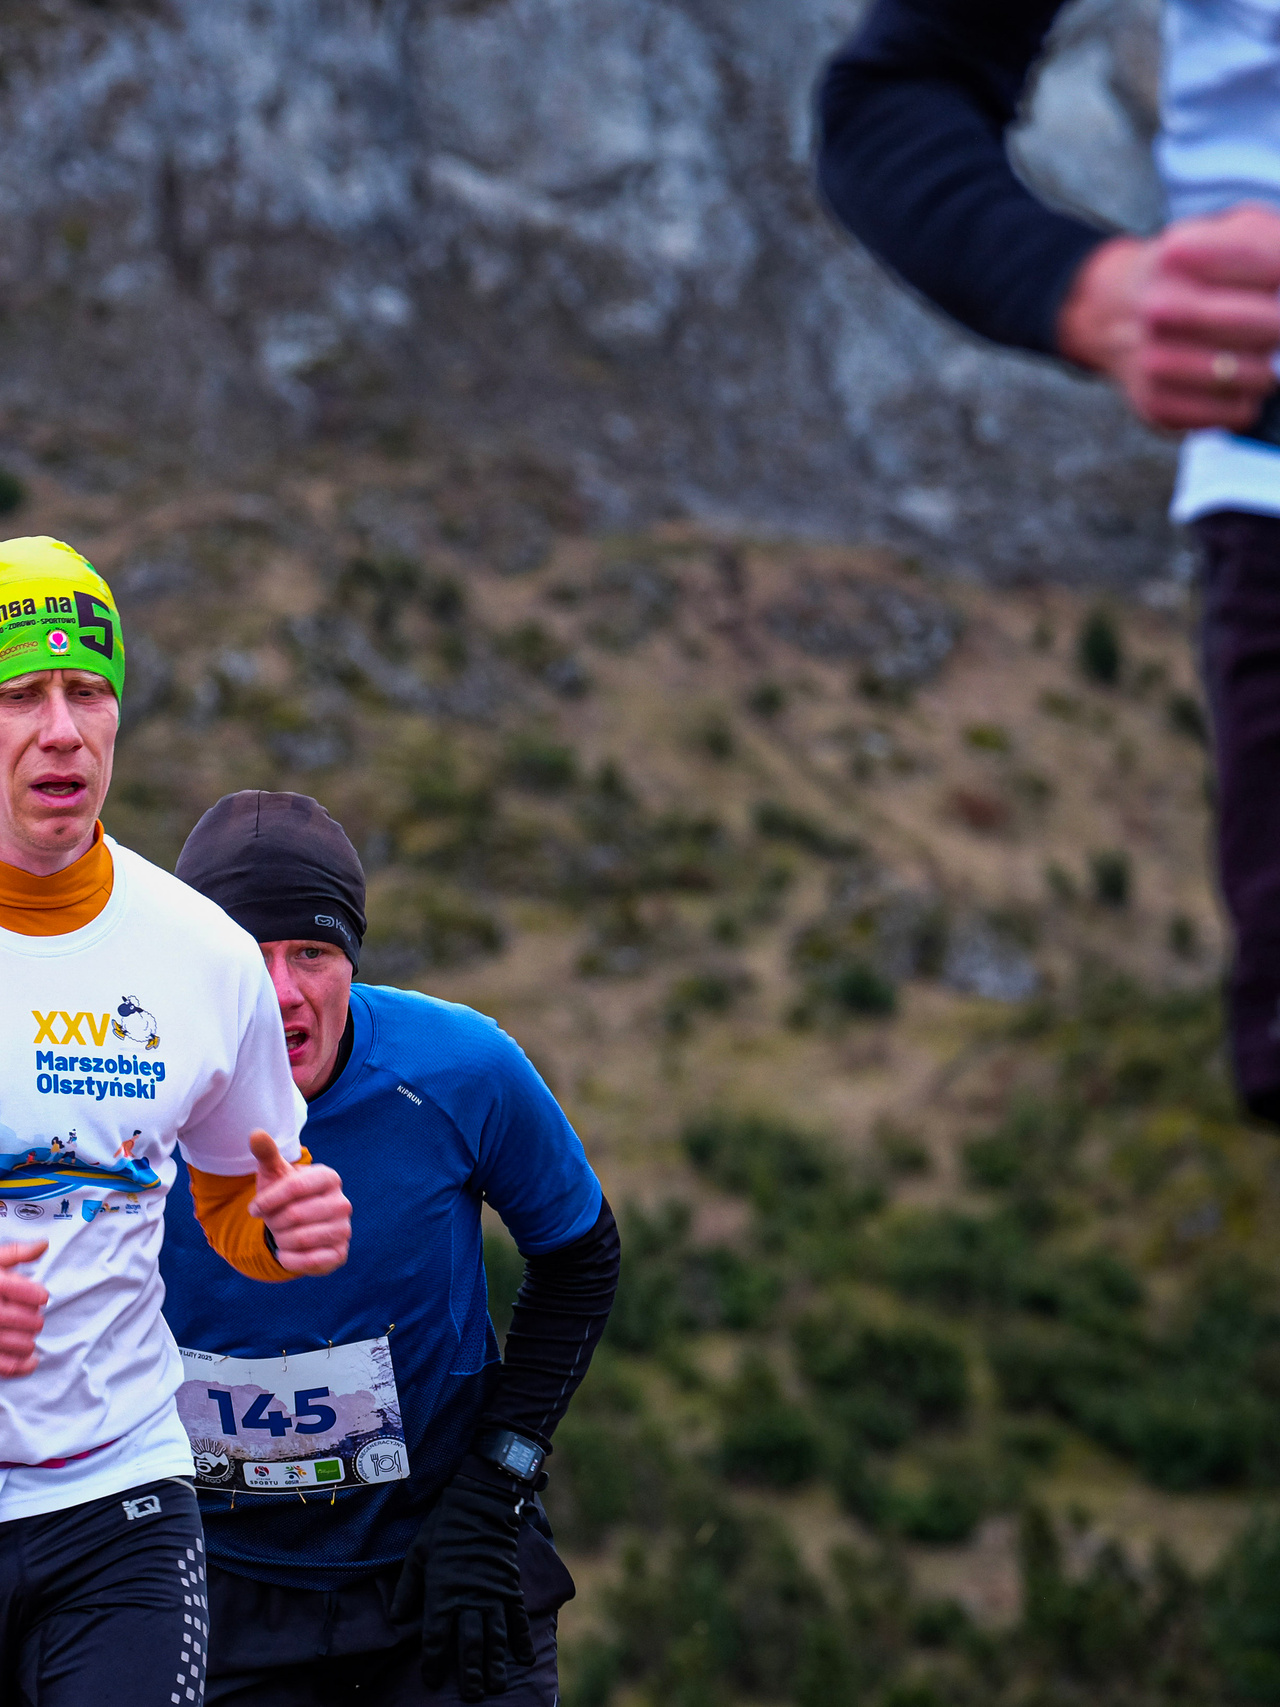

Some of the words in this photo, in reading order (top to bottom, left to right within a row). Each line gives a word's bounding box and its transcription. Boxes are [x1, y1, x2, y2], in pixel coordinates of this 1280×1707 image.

[45, 597, 73, 613] na
[73, 590, 114, 661] 5
[31, 1010, 111, 1047] XXV
[35, 1050, 166, 1082] Marszobieg
[36, 1073, 156, 1101] Olsztyński
[396, 1085, 423, 1106] KIPRUN
[207, 1386, 337, 1438] 145
[195, 1458, 212, 1473] 5
